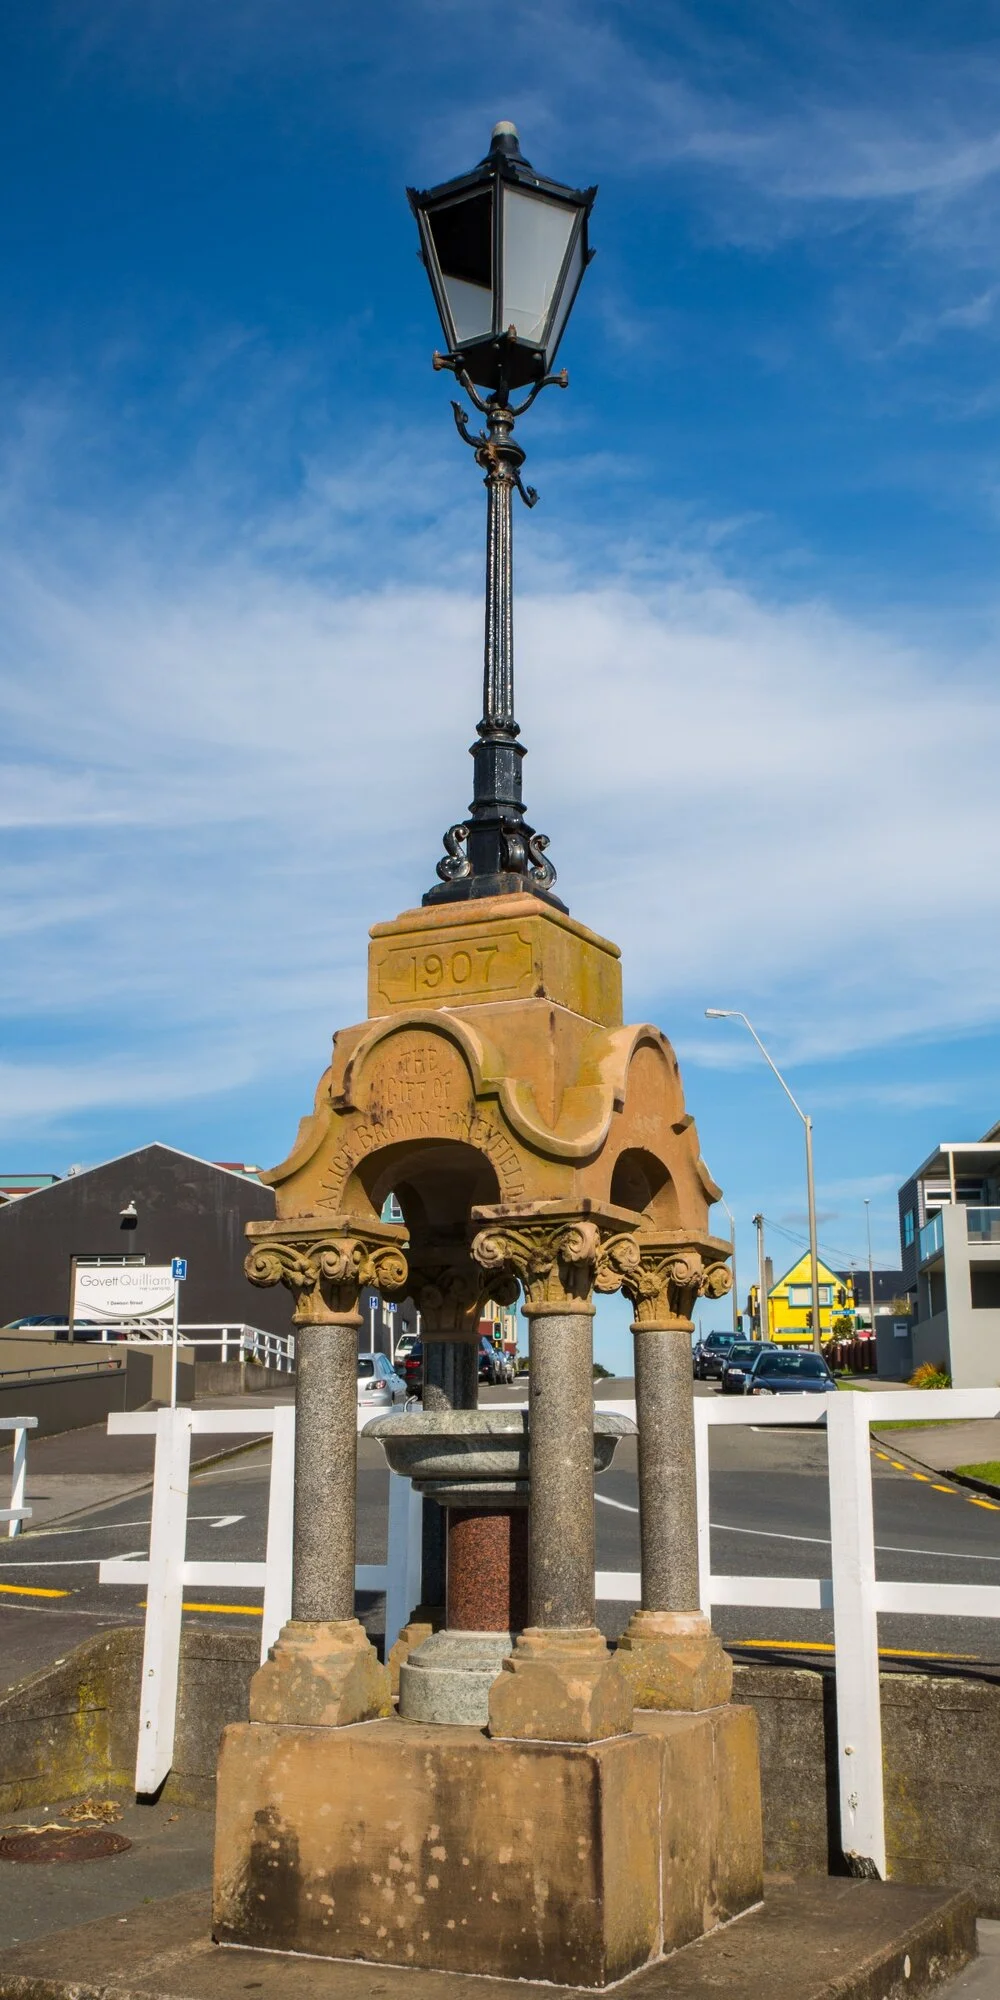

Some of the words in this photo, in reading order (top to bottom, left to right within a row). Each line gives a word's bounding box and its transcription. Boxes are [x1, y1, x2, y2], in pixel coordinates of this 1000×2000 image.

[410, 945, 499, 993] 1907
[401, 1048, 438, 1074] THE
[387, 1079, 425, 1106] GIFT
[433, 1077, 451, 1099] OF
[316, 1142, 358, 1210] ALICE
[354, 1110, 431, 1150] BROWN
[437, 1106, 526, 1198] HONEYFIELD
[176, 1260, 182, 1268] P
[80, 1274, 118, 1287] Govett
[120, 1273, 171, 1287] Quilliam
